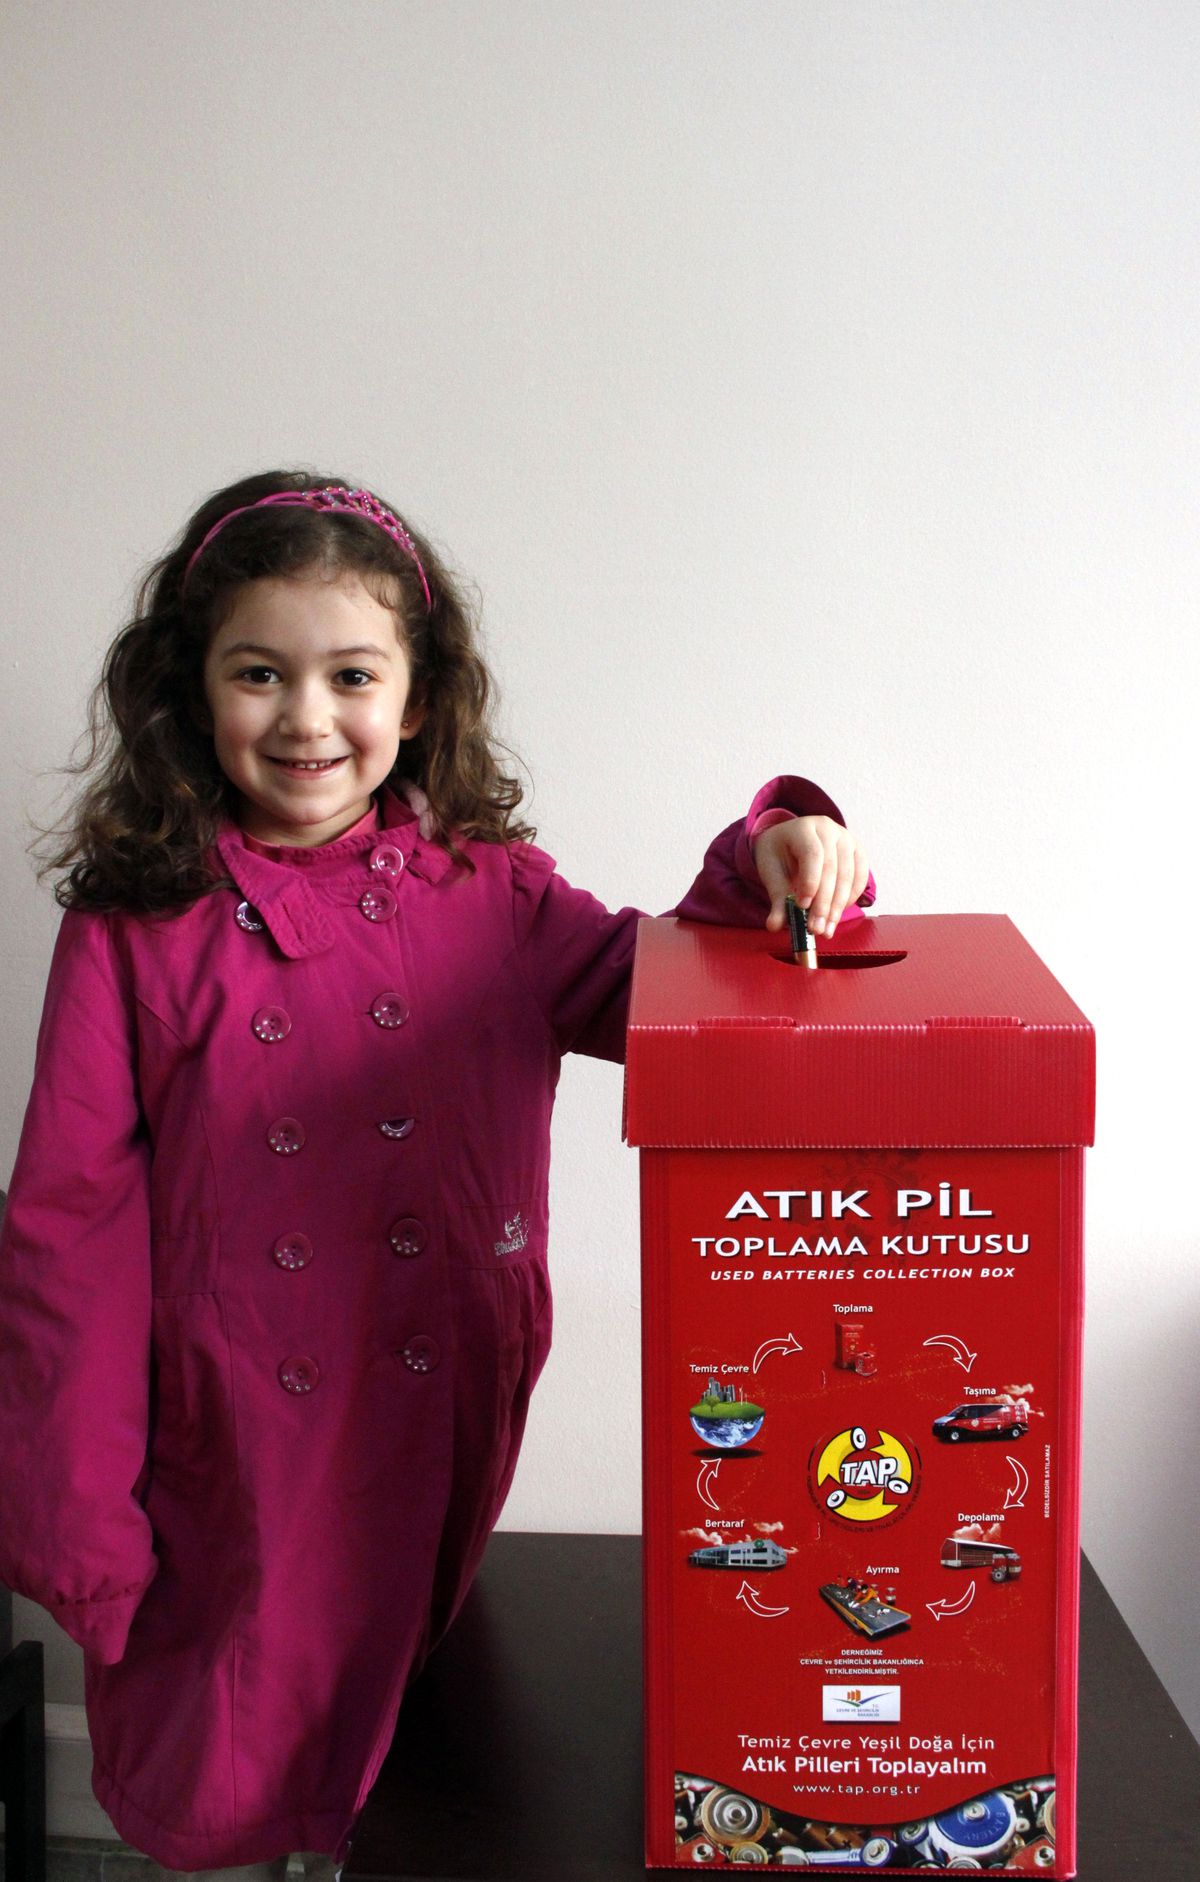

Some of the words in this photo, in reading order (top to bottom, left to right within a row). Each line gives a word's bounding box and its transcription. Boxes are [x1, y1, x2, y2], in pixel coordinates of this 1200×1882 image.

[725, 1190, 871, 1219] ATIK
[896, 1182, 993, 1218] PİL
[691, 1236, 868, 1257] TOPLAMA
[881, 1234, 1030, 1256] KUTUSU
[710, 1270, 755, 1281] USED
[762, 1269, 855, 1281] BATTERIES
[863, 1268, 973, 1280] COLLECTION
[980, 1267, 1016, 1279] BOX
[832, 1303, 874, 1315] Toplama
[689, 1364, 719, 1374] Temiz
[721, 1363, 750, 1376] Çevre
[963, 1386, 997, 1397] Taşıma
[841, 1456, 897, 1486] TAP
[704, 1518, 745, 1529] Bertaraf
[957, 1512, 1006, 1526] Depolama
[865, 1565, 900, 1577] Ayırma
[841, 1648, 883, 1656] DERNEĞİMİZ
[800, 1658, 823, 1666] ÇEVRE
[872, 1658, 925, 1666] BAKANLIĞINCA
[738, 1735, 791, 1749] Temiz
[798, 1736, 852, 1752] Çevre
[858, 1735, 901, 1753] Yeşil
[909, 1735, 953, 1753] Doğa
[961, 1734, 995, 1753] İçin
[741, 1756, 787, 1773] Atık
[794, 1756, 860, 1774] Pilleri
[867, 1756, 987, 1778] Toplayalım
[793, 1785, 920, 1796] www.tap.org.tr
